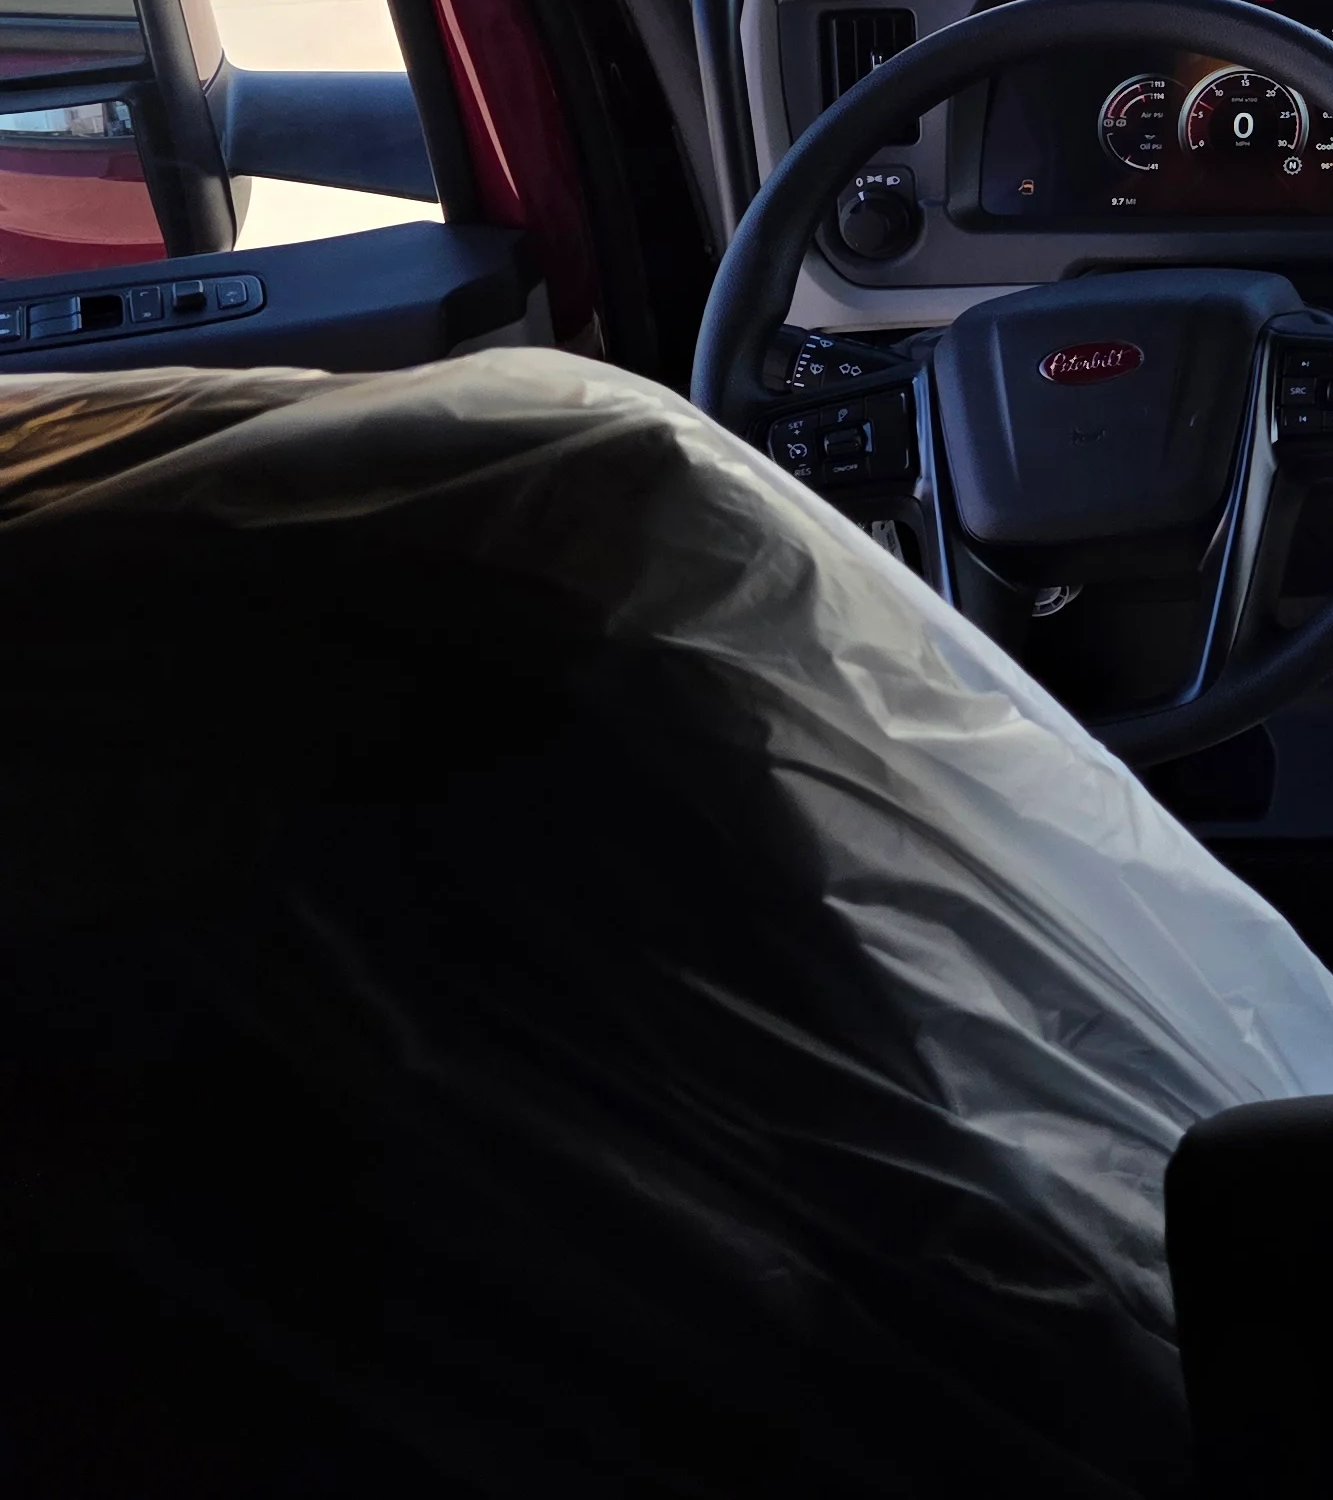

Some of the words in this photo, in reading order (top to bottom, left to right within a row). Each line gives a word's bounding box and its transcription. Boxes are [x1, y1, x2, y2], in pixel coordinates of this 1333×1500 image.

[1233, 112, 1254, 139] 0
[1049, 349, 1131, 376] Peterbilt
[1289, 387, 1307, 395] SRC
[787, 421, 803, 430] SET
[794, 467, 812, 476] RES
